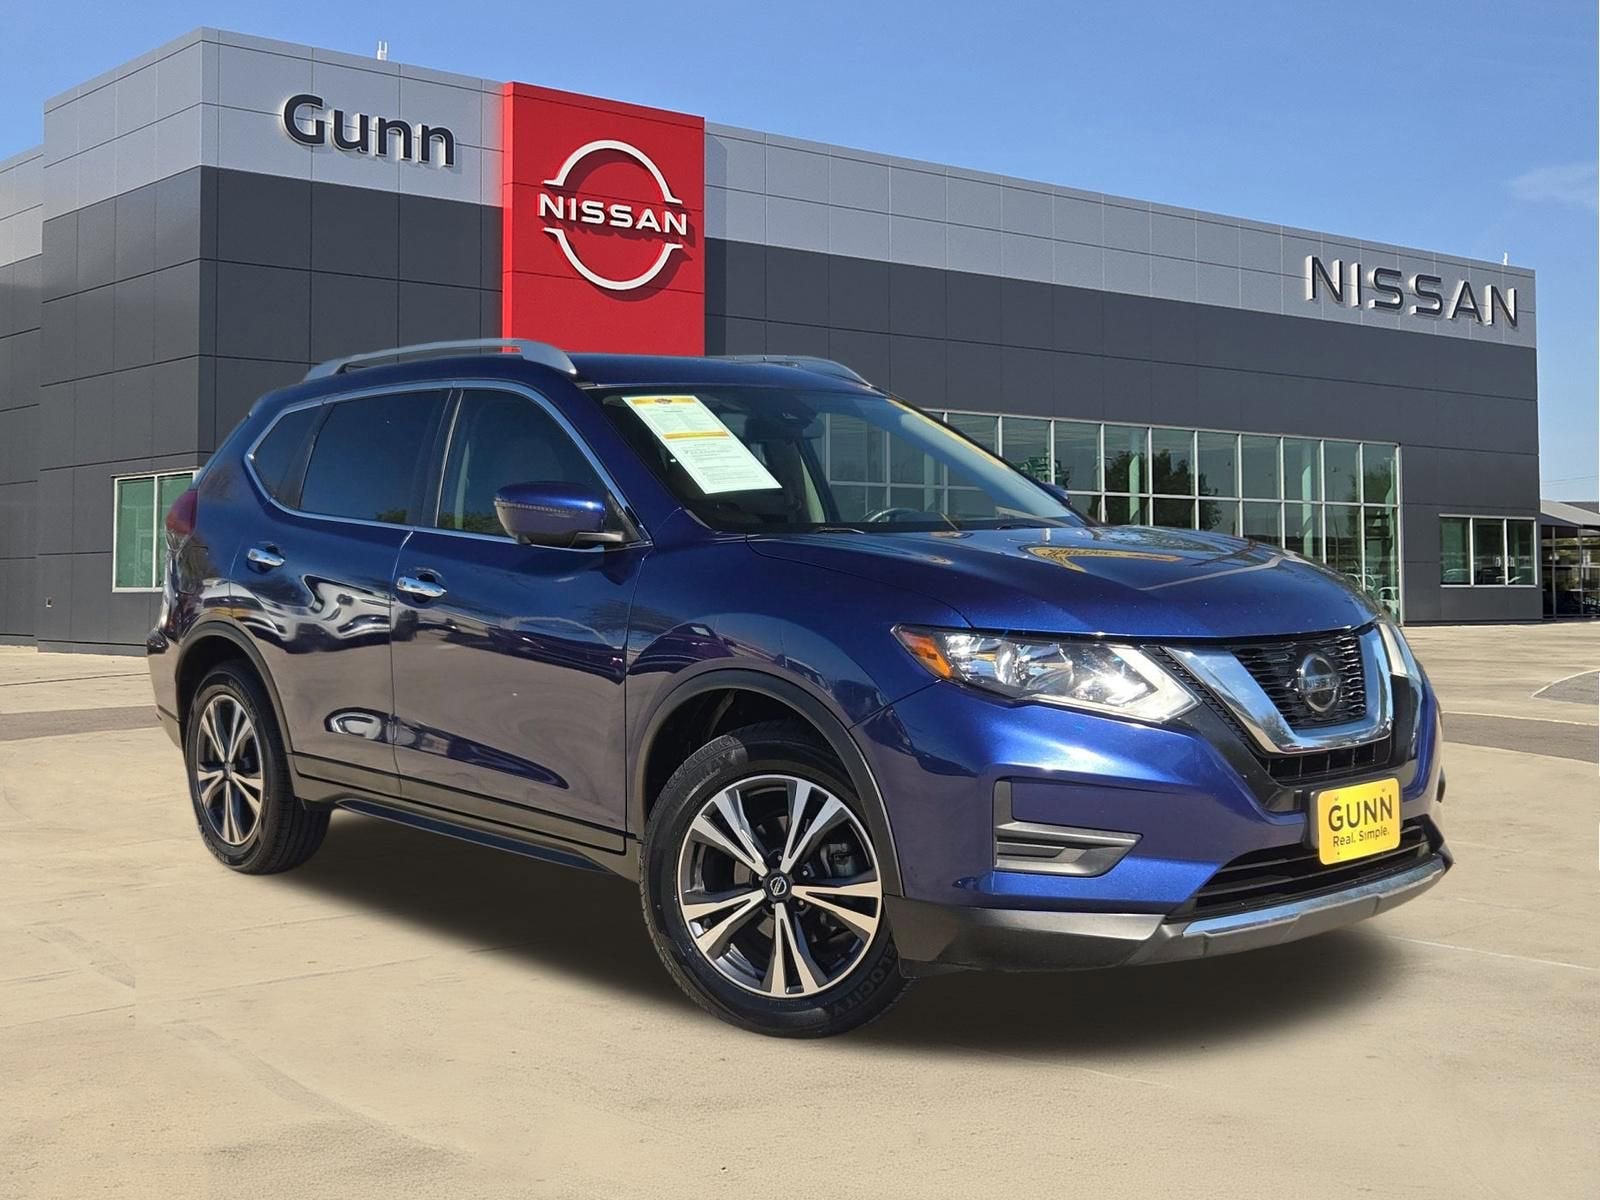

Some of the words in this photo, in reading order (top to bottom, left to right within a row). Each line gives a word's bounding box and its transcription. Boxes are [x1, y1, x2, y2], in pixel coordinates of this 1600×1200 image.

[281, 94, 456, 167] Gunn
[537, 192, 688, 236] NISSAN
[1305, 255, 1518, 328] NISSAN
[1328, 794, 1393, 832] GUNN
[1332, 832, 1357, 848] Real.
[1358, 826, 1390, 842] Simple.
